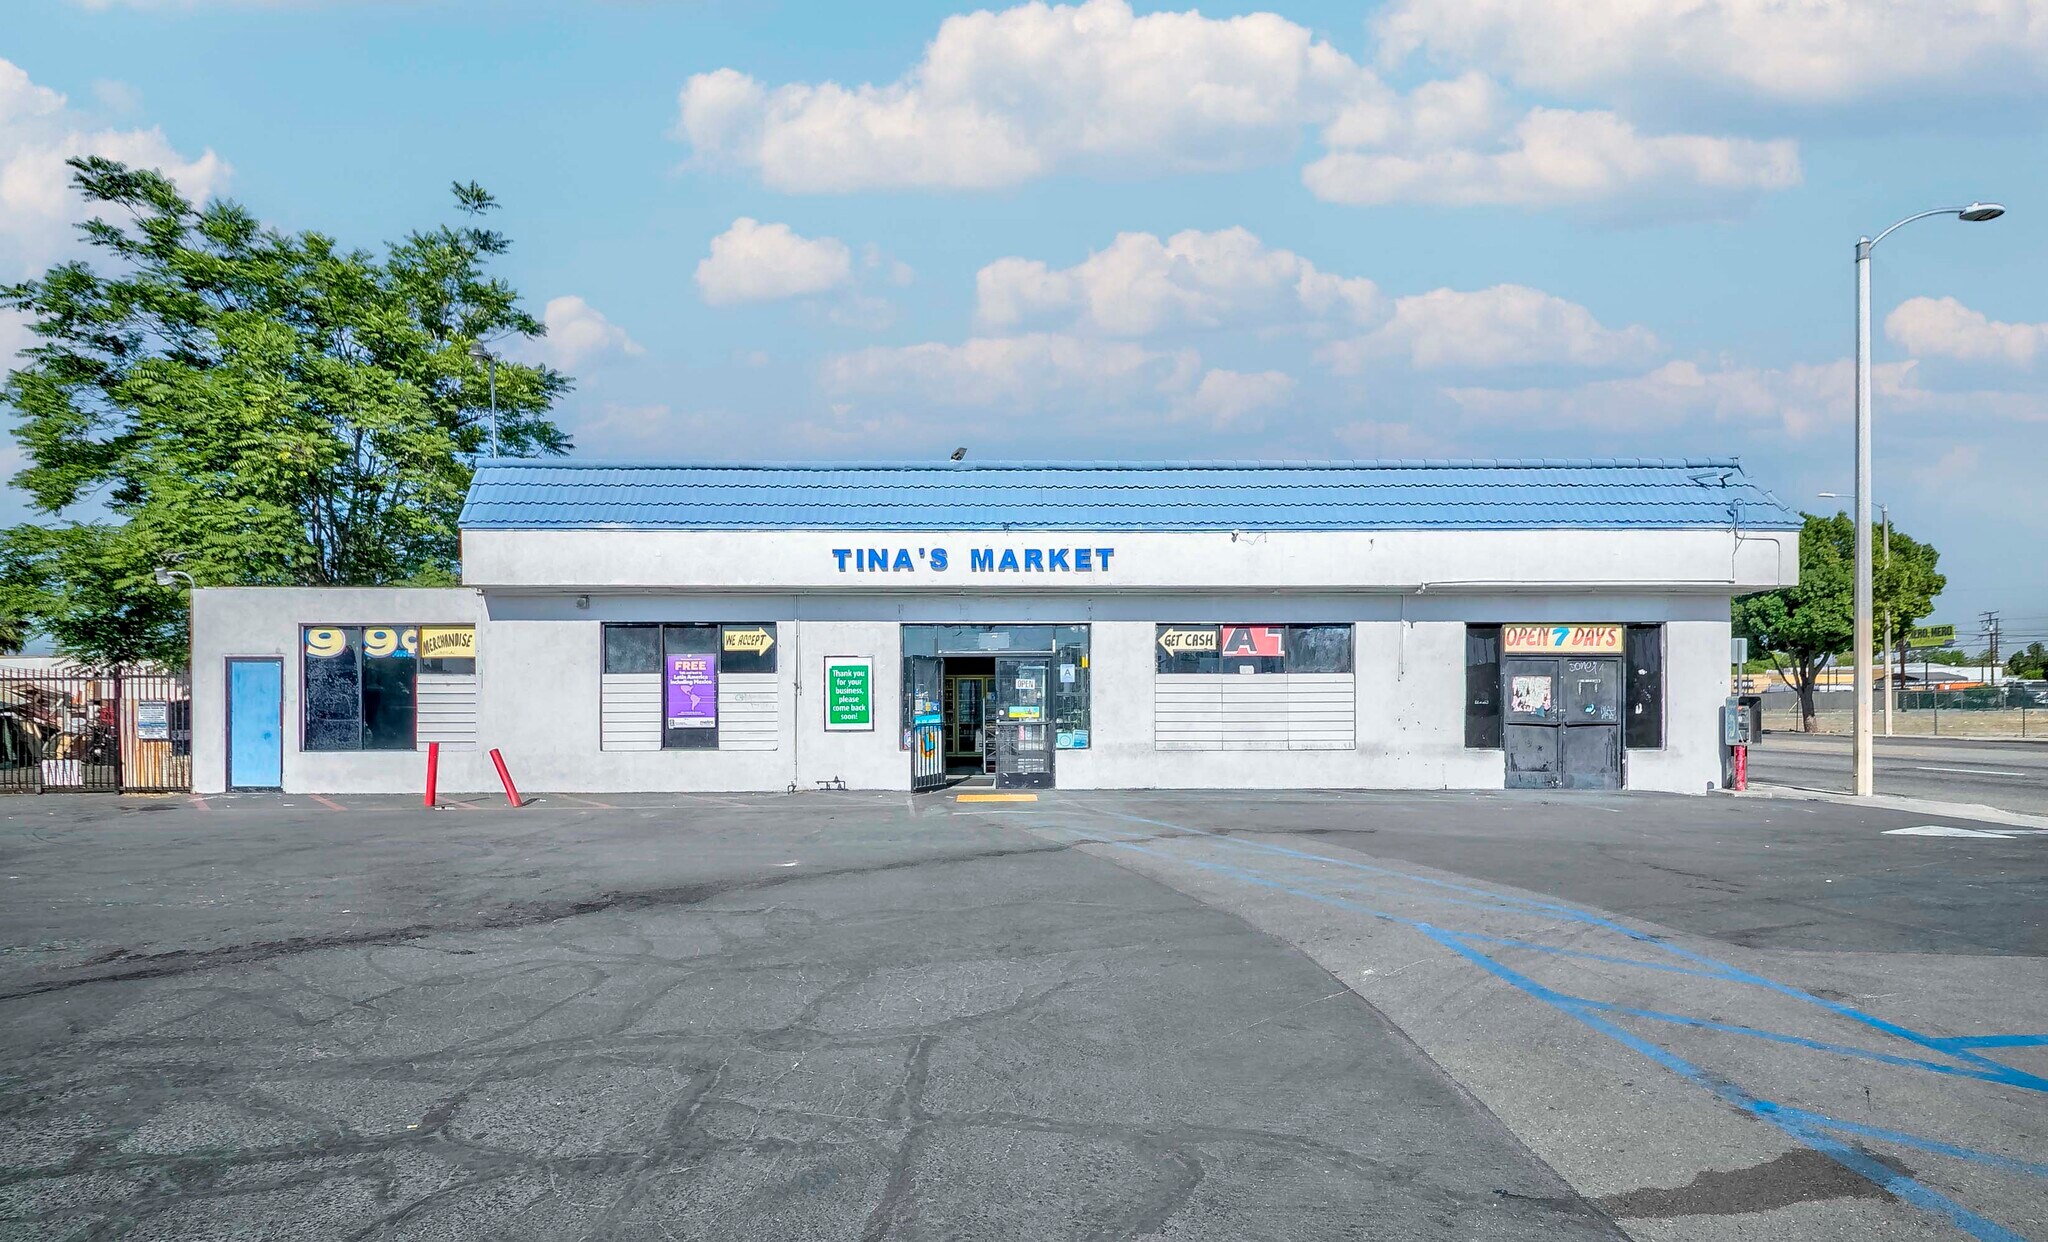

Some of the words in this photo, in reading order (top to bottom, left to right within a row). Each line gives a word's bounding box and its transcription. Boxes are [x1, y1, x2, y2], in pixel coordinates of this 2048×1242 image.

[832, 548, 949, 572] TINA'S
[970, 548, 1115, 572] MARKET
[726, 634, 736, 646] WE
[738, 634, 767, 646] ACCEPT
[1164, 634, 1183, 647] GET
[1185, 634, 1214, 647] CASH
[1506, 627, 1550, 647] OPEN
[1552, 626, 1570, 647] 7
[1571, 627, 1617, 647] DAYS
[423, 633, 473, 656] MERCHANDISE
[675, 661, 707, 671] FREE
[1064, 668, 1071, 676] A
[836, 678, 847, 686] for
[848, 679, 863, 687] your
[1017, 680, 1034, 688] OPEN
[835, 687, 864, 695] business,
[838, 695, 860, 704] please
[840, 712, 858, 720] soon!
